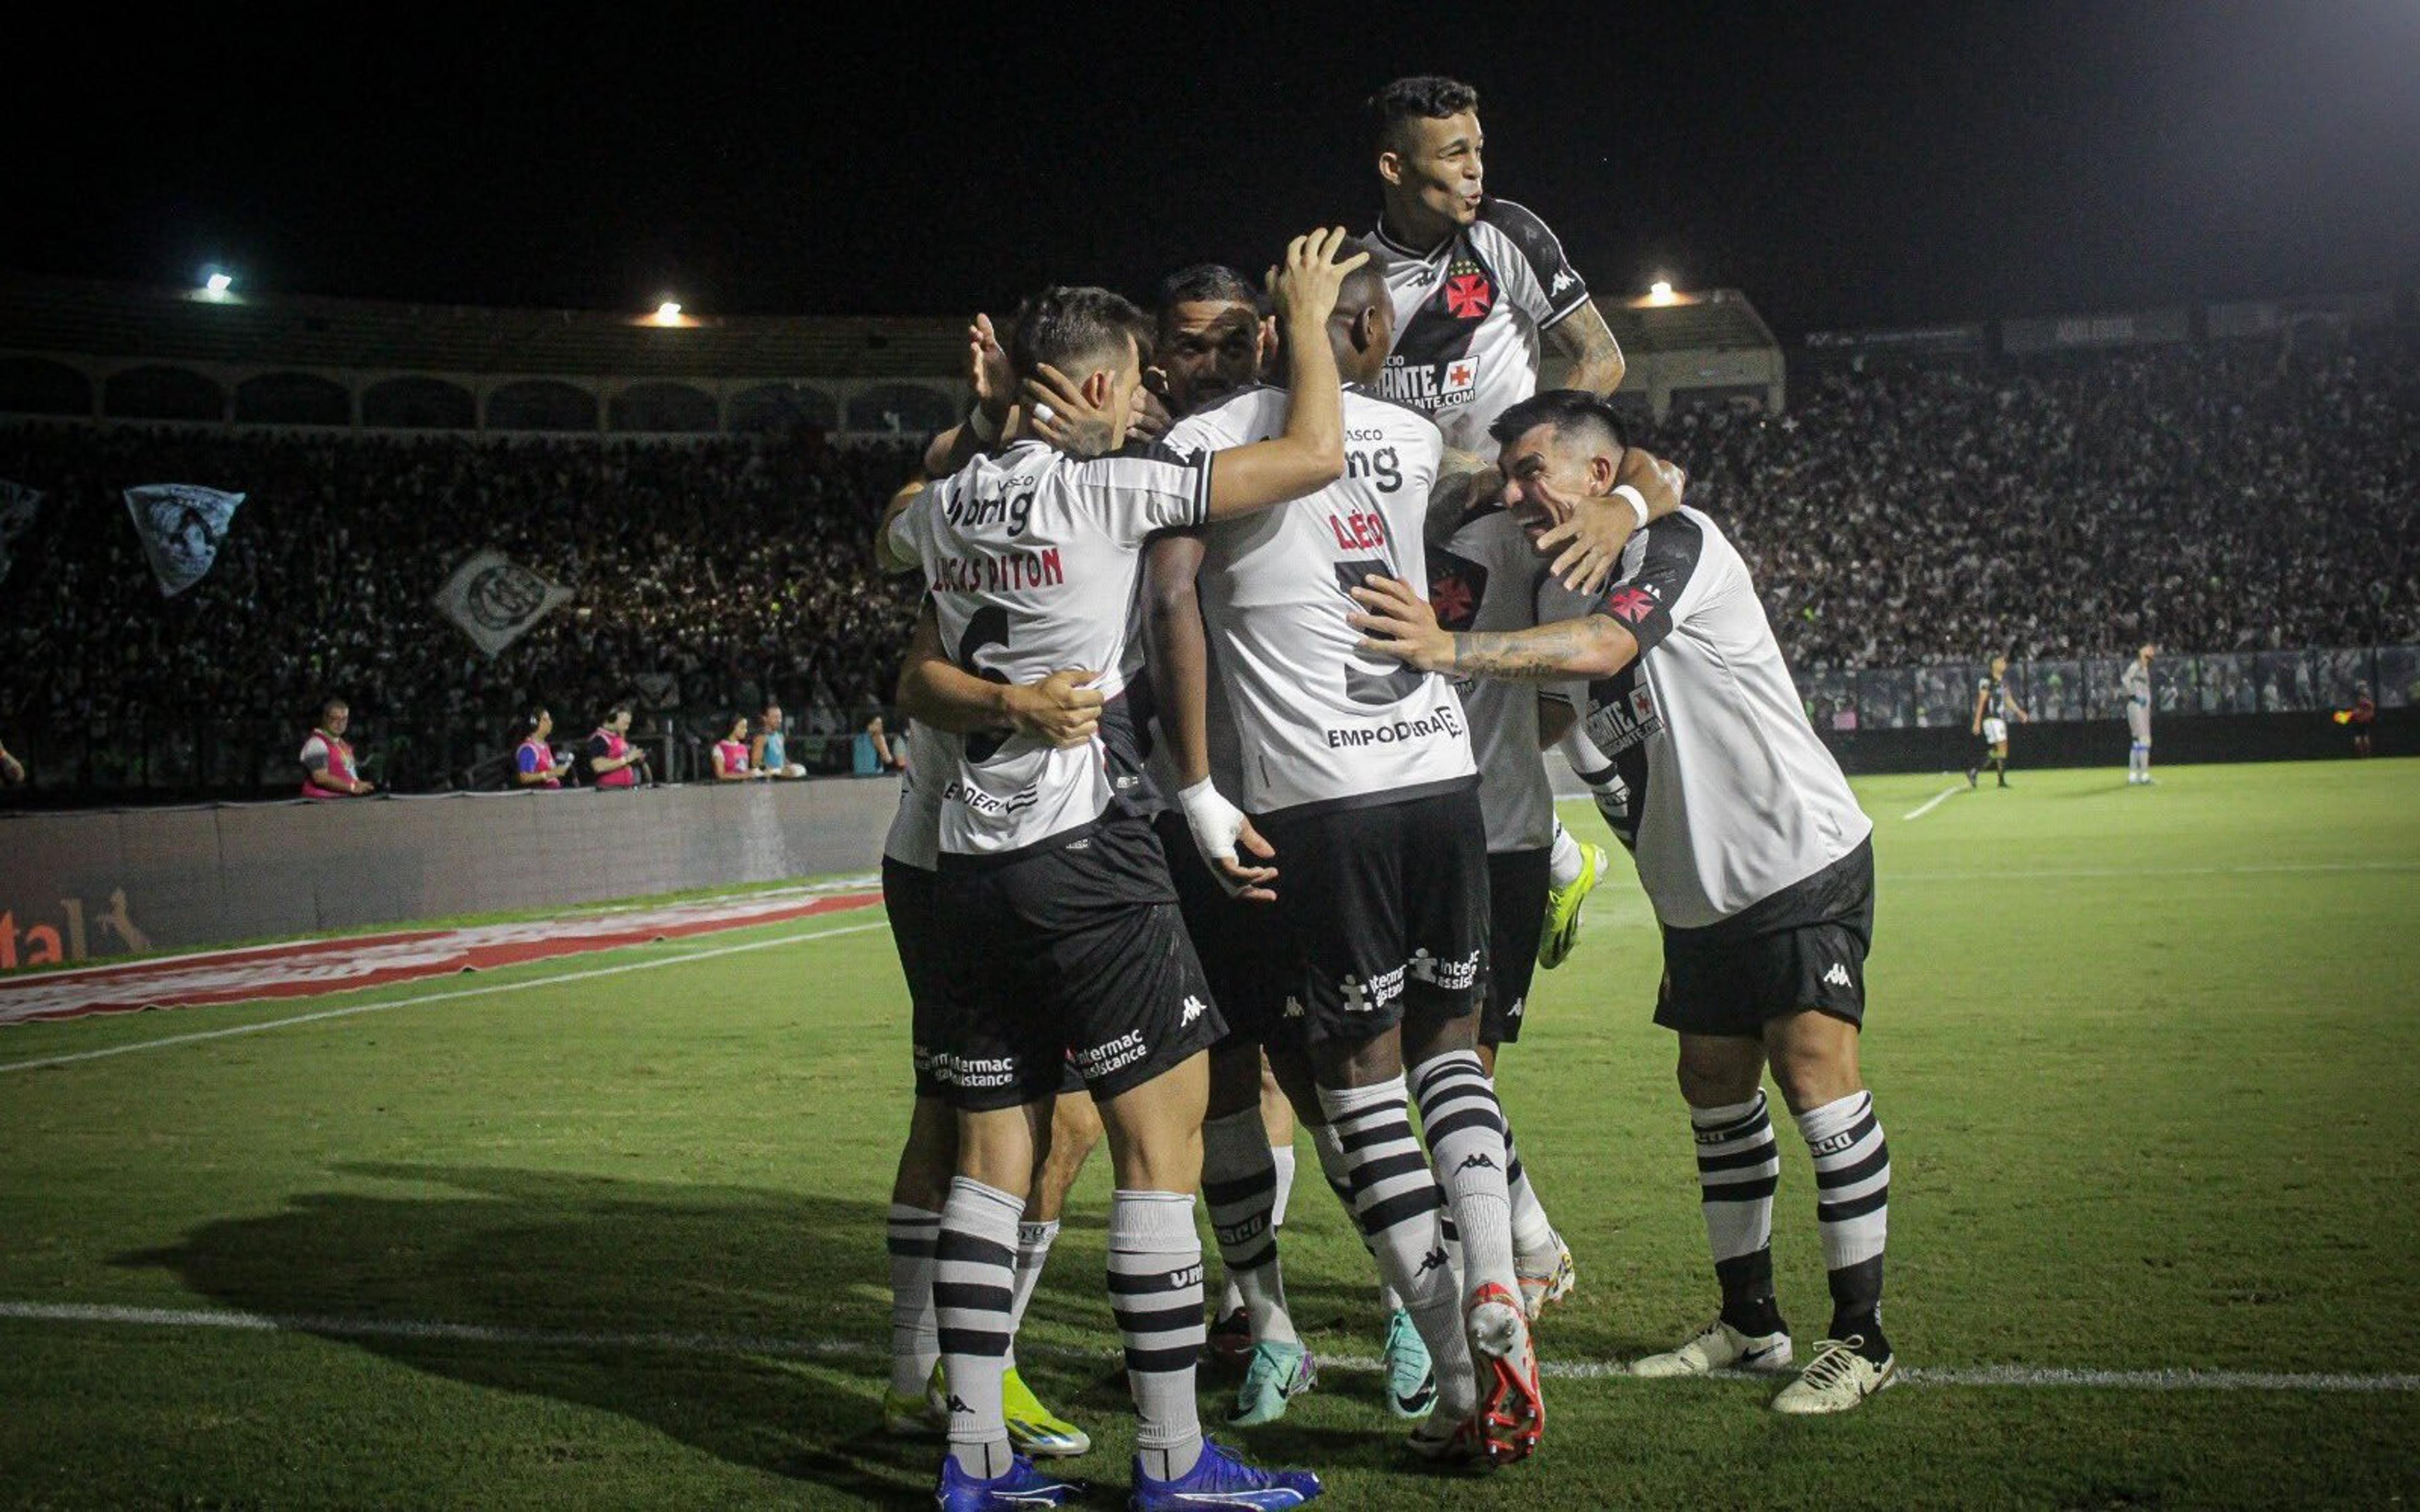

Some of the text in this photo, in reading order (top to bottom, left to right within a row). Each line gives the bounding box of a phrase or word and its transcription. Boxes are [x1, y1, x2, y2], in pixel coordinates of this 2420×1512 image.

[1345, 429, 1383, 441] ASCO
[1329, 509, 1384, 549] LÉO
[987, 548, 1064, 593] PITON
